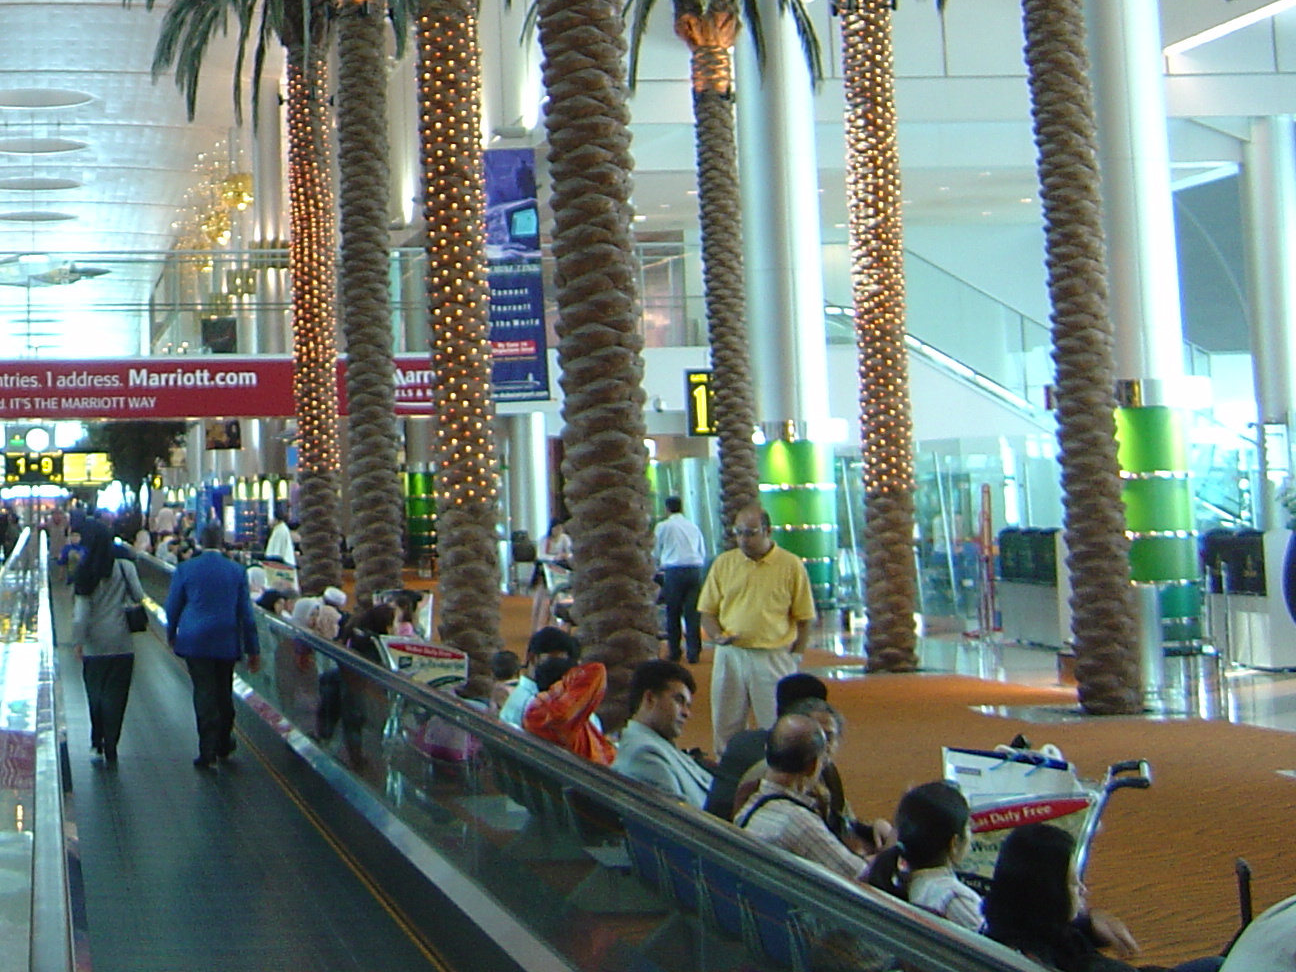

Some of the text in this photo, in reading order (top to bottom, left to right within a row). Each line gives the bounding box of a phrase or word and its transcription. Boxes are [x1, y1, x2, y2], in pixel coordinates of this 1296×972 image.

[45, 370, 53, 387] 1
[56, 370, 124, 388] address.
[128, 368, 258, 387] Marriott.com
[9, 396, 32, 410] IT'S
[33, 396, 59, 410] THE
[61, 396, 126, 410] MARRIOTT
[127, 395, 157, 409] WAY
